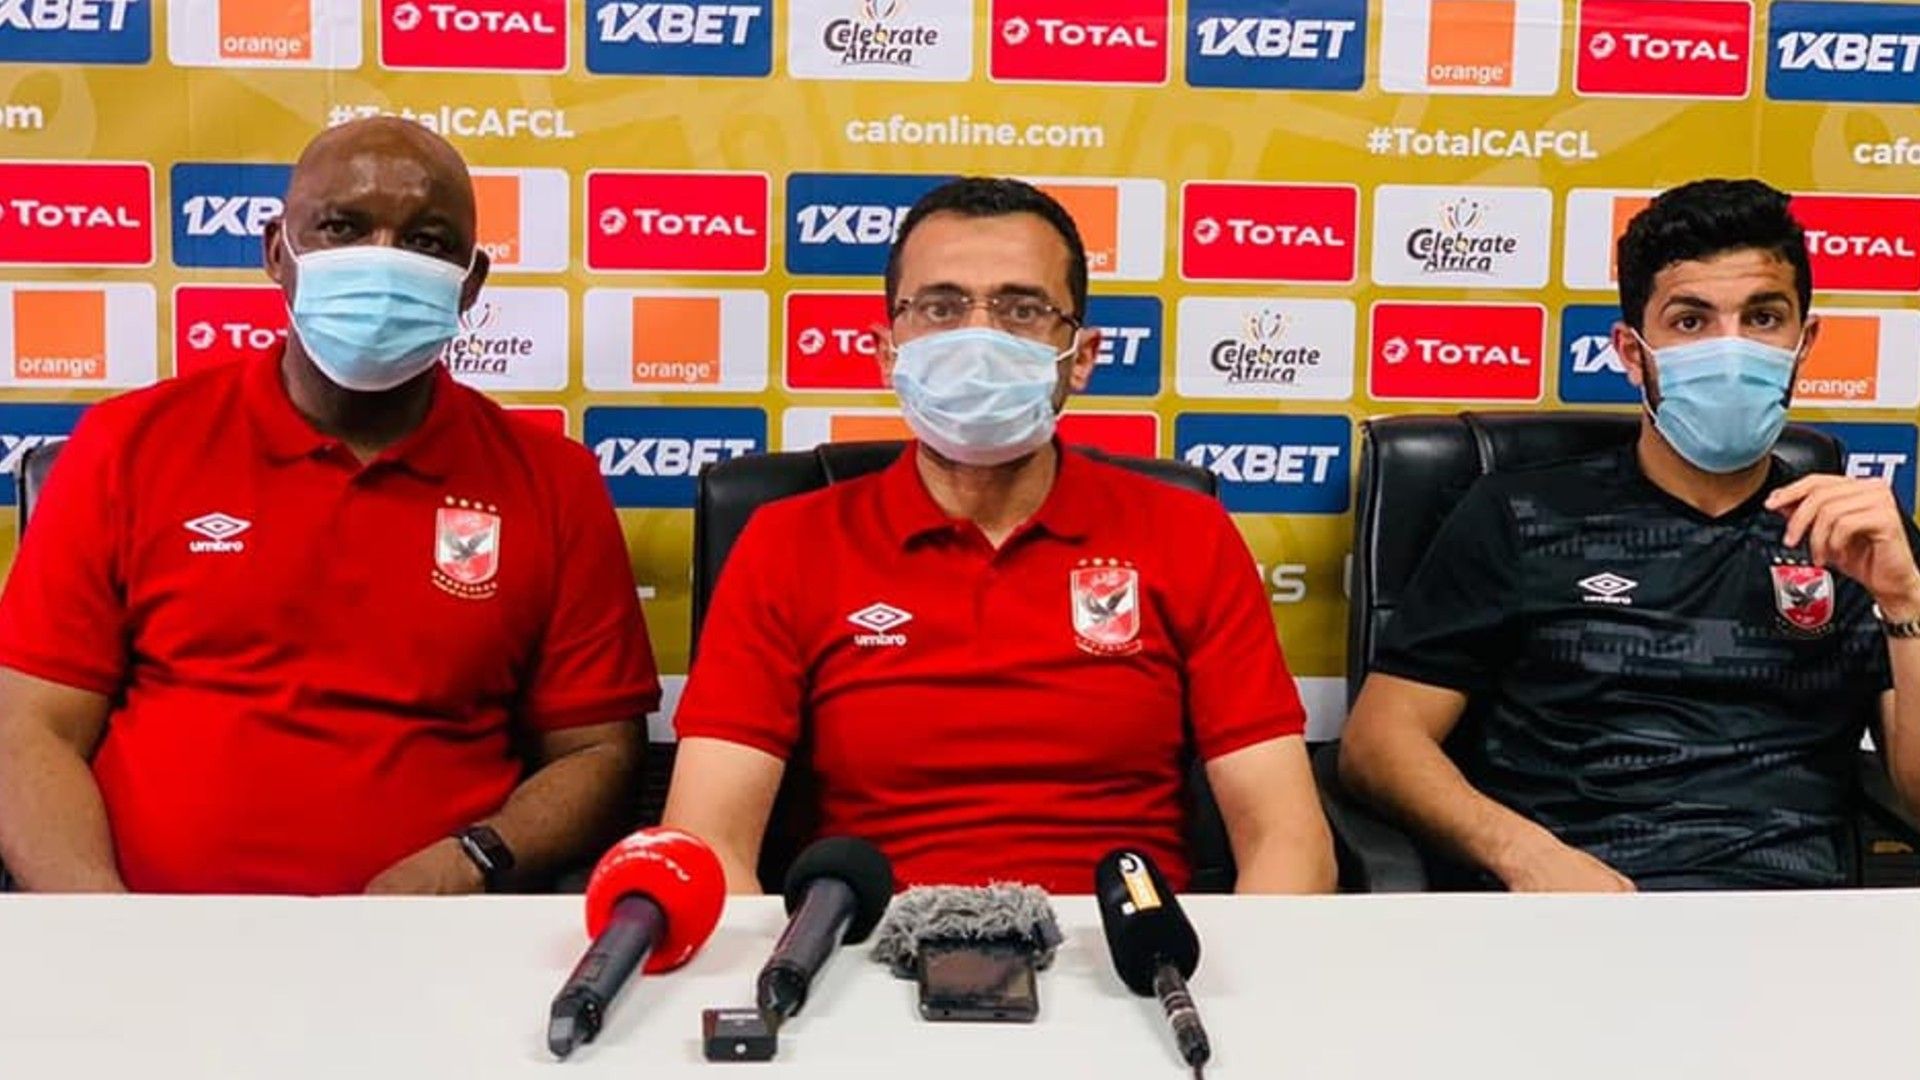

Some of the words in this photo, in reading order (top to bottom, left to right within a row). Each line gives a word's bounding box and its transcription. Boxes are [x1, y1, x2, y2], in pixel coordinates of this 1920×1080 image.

[428, 4, 555, 33] TOTAL
[596, 3, 760, 44] 1XBET
[223, 35, 303, 56] orange
[824, 19, 938, 52] Celebrate
[1036, 18, 1158, 47] TOTAL
[1197, 18, 1356, 59] 1XBET
[841, 43, 912, 65] Africa
[1622, 33, 1739, 61] TOTAL
[1430, 64, 1504, 83] orange
[0, 105, 43, 128] m
[846, 115, 1104, 148] cafonline.com
[1366, 128, 1598, 159] #TotalCAFCL
[12, 199, 141, 228] TOTAL
[632, 209, 756, 236] TOTAL
[1228, 219, 1345, 247] TOTAL
[1407, 227, 1517, 259] Celebrate
[1804, 230, 1915, 257] TOTAL
[1423, 249, 1491, 272] Africa
[1210, 339, 1321, 372] Celebrate
[1414, 338, 1532, 366] TOTAL
[18, 356, 98, 378] orange
[635, 361, 711, 382] orange
[1227, 363, 1296, 384] Africa
[1797, 377, 1869, 396] orange
[189, 540, 244, 553] umbro
[853, 632, 908, 647] umbro
